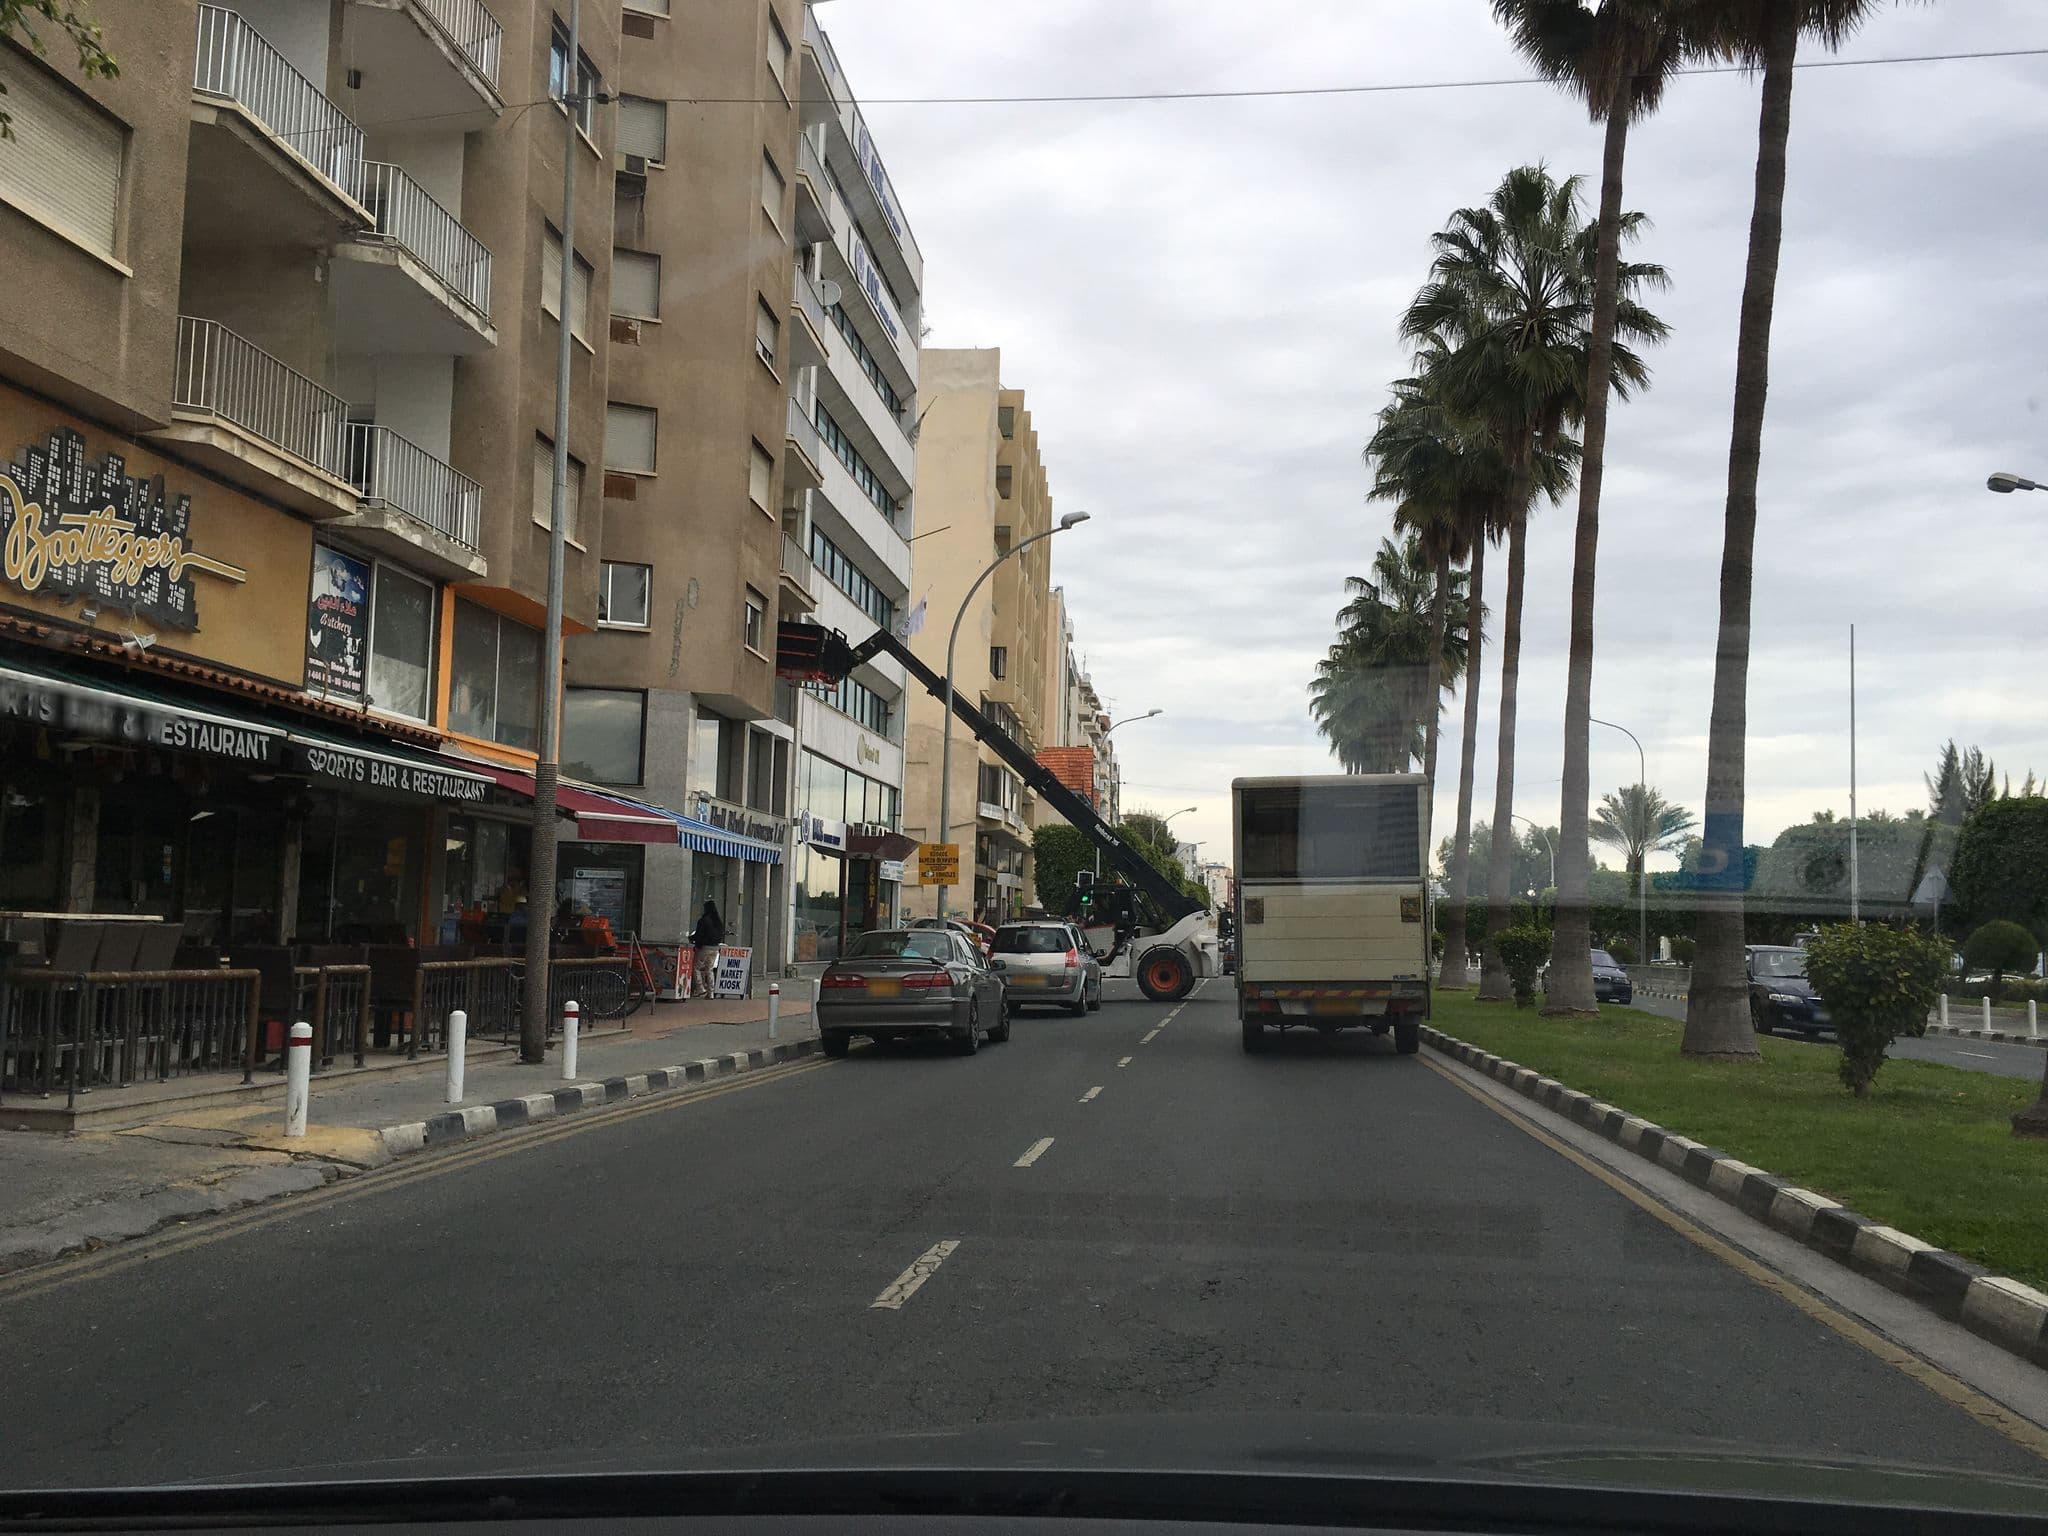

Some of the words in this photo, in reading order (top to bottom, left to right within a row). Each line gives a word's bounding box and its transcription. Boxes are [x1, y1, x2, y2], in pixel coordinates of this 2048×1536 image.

[0, 474, 247, 591] Bootleggers
[320, 612, 352, 636] Butchery
[148, 717, 270, 760] ESTAURANT
[307, 749, 364, 781] SPORTS
[371, 762, 397, 788] BAR
[400, 768, 410, 790] &
[413, 771, 486, 801] RESTAURANT
[720, 947, 749, 957] INTERNET
[727, 958, 741, 968] MINI
[720, 969, 743, 979] MARKET
[719, 980, 741, 990] KIOSK
